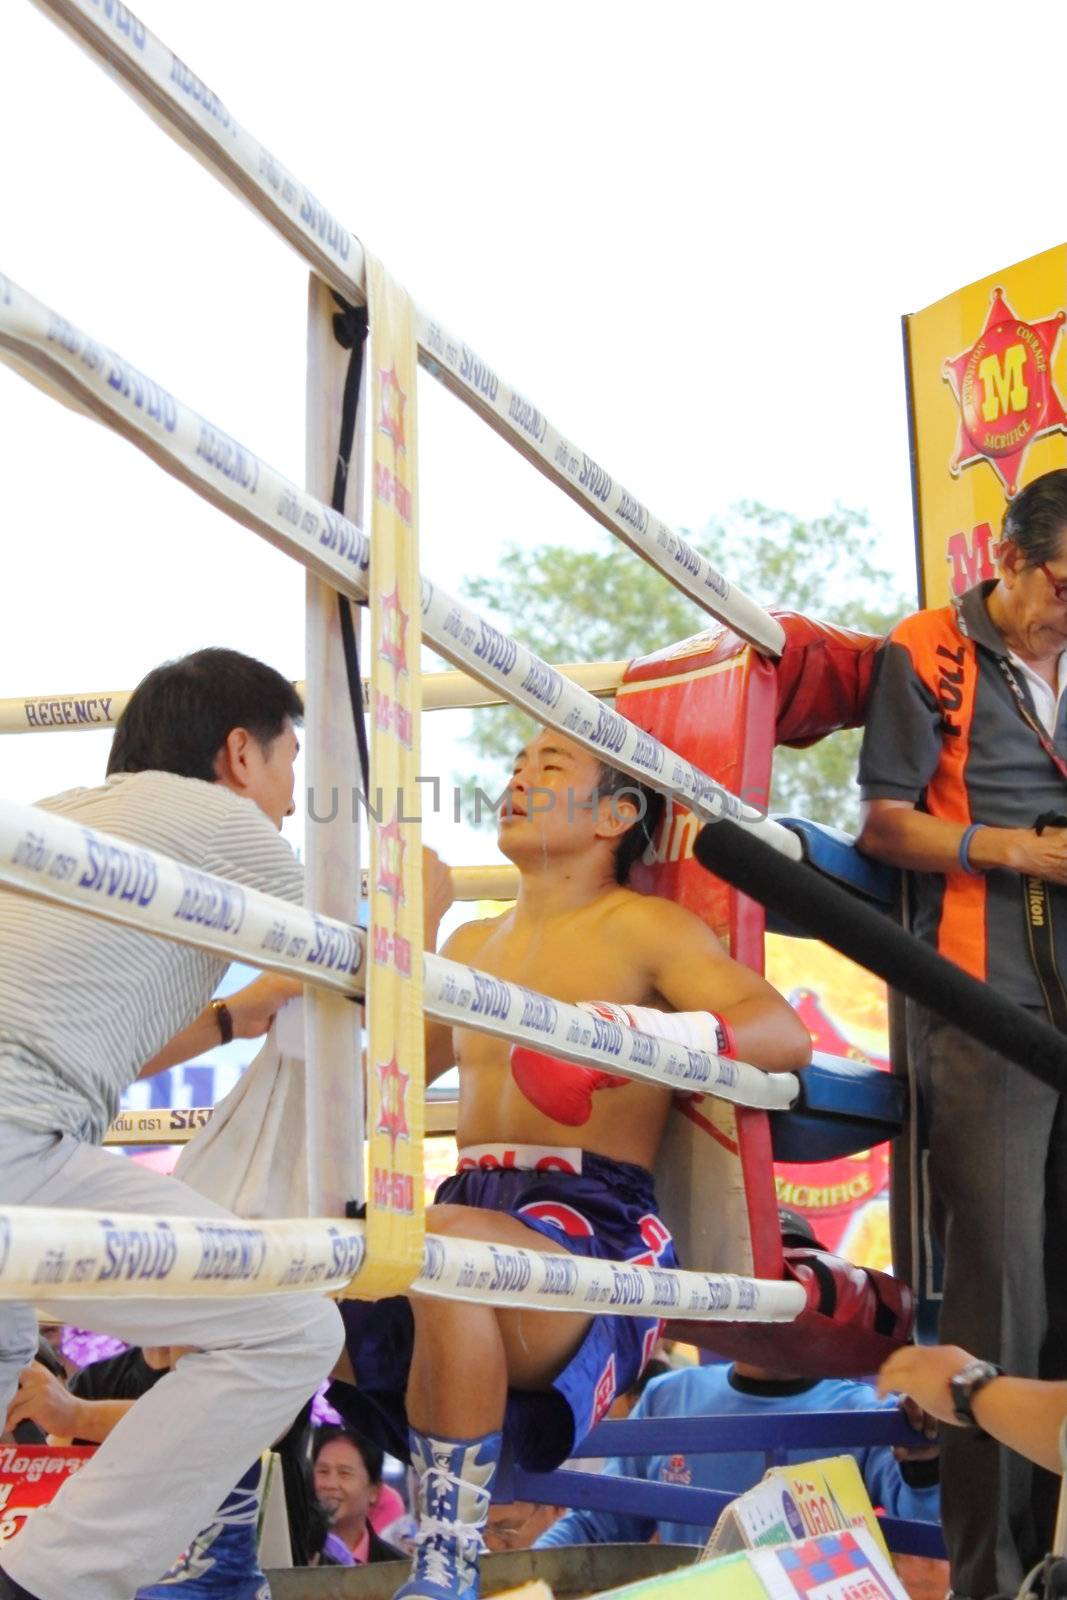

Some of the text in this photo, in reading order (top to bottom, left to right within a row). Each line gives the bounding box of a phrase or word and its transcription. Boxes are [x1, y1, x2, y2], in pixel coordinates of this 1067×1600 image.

[979, 343, 1028, 423] M
[984, 419, 1031, 450] SACRIFICE
[935, 644, 965, 737] FULL
[24, 698, 114, 727] REGENCY
[1026, 876, 1045, 927] Nikon
[138, 1118, 162, 1131] ตรา
